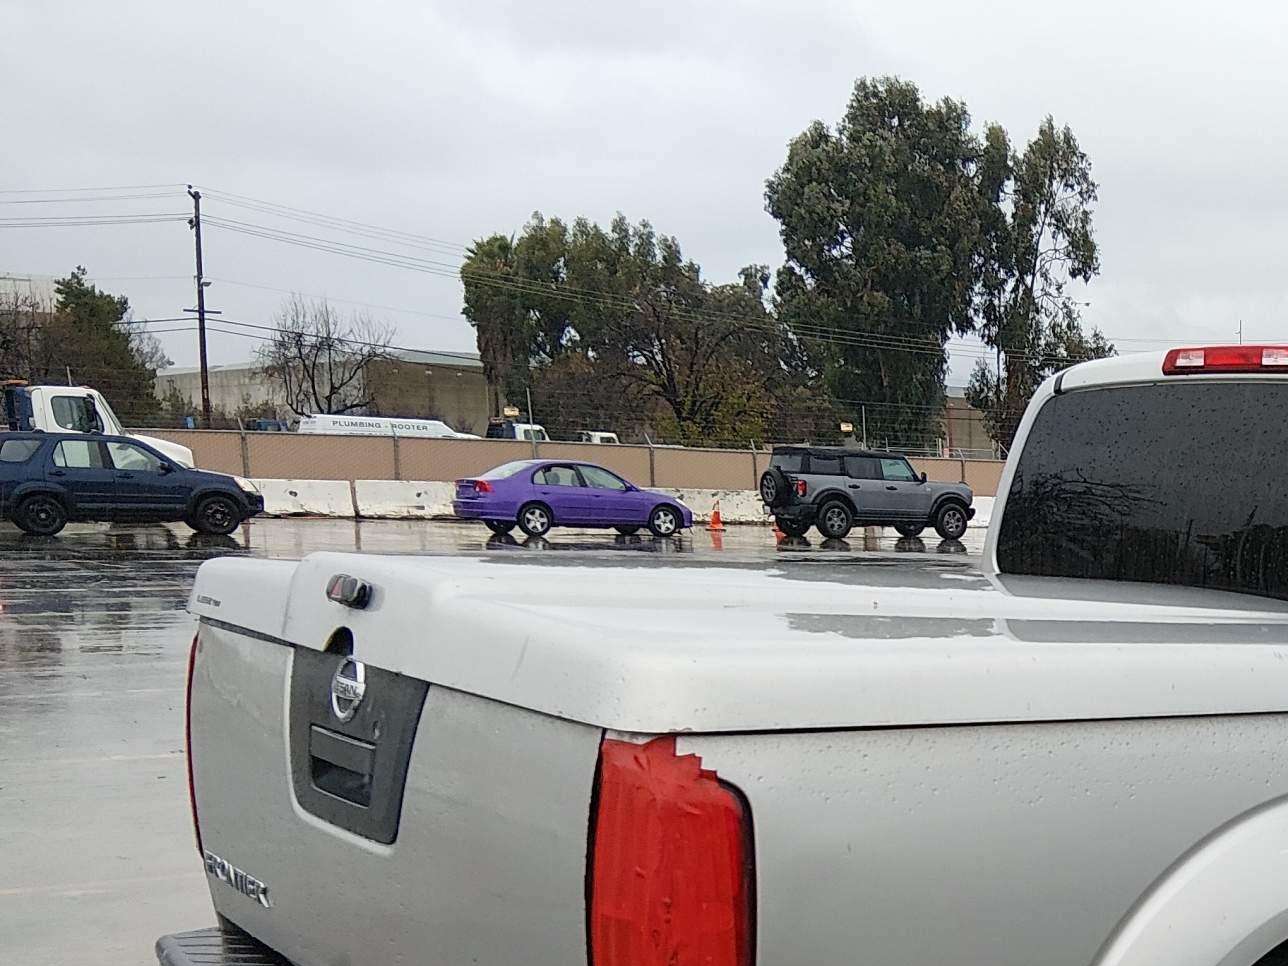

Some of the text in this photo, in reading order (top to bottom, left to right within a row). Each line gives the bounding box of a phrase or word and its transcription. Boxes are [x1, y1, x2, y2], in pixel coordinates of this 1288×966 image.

[332, 420, 381, 429] PLUMBING
[391, 423, 428, 431] ROOTER
[204, 850, 271, 908] FRONTIER
